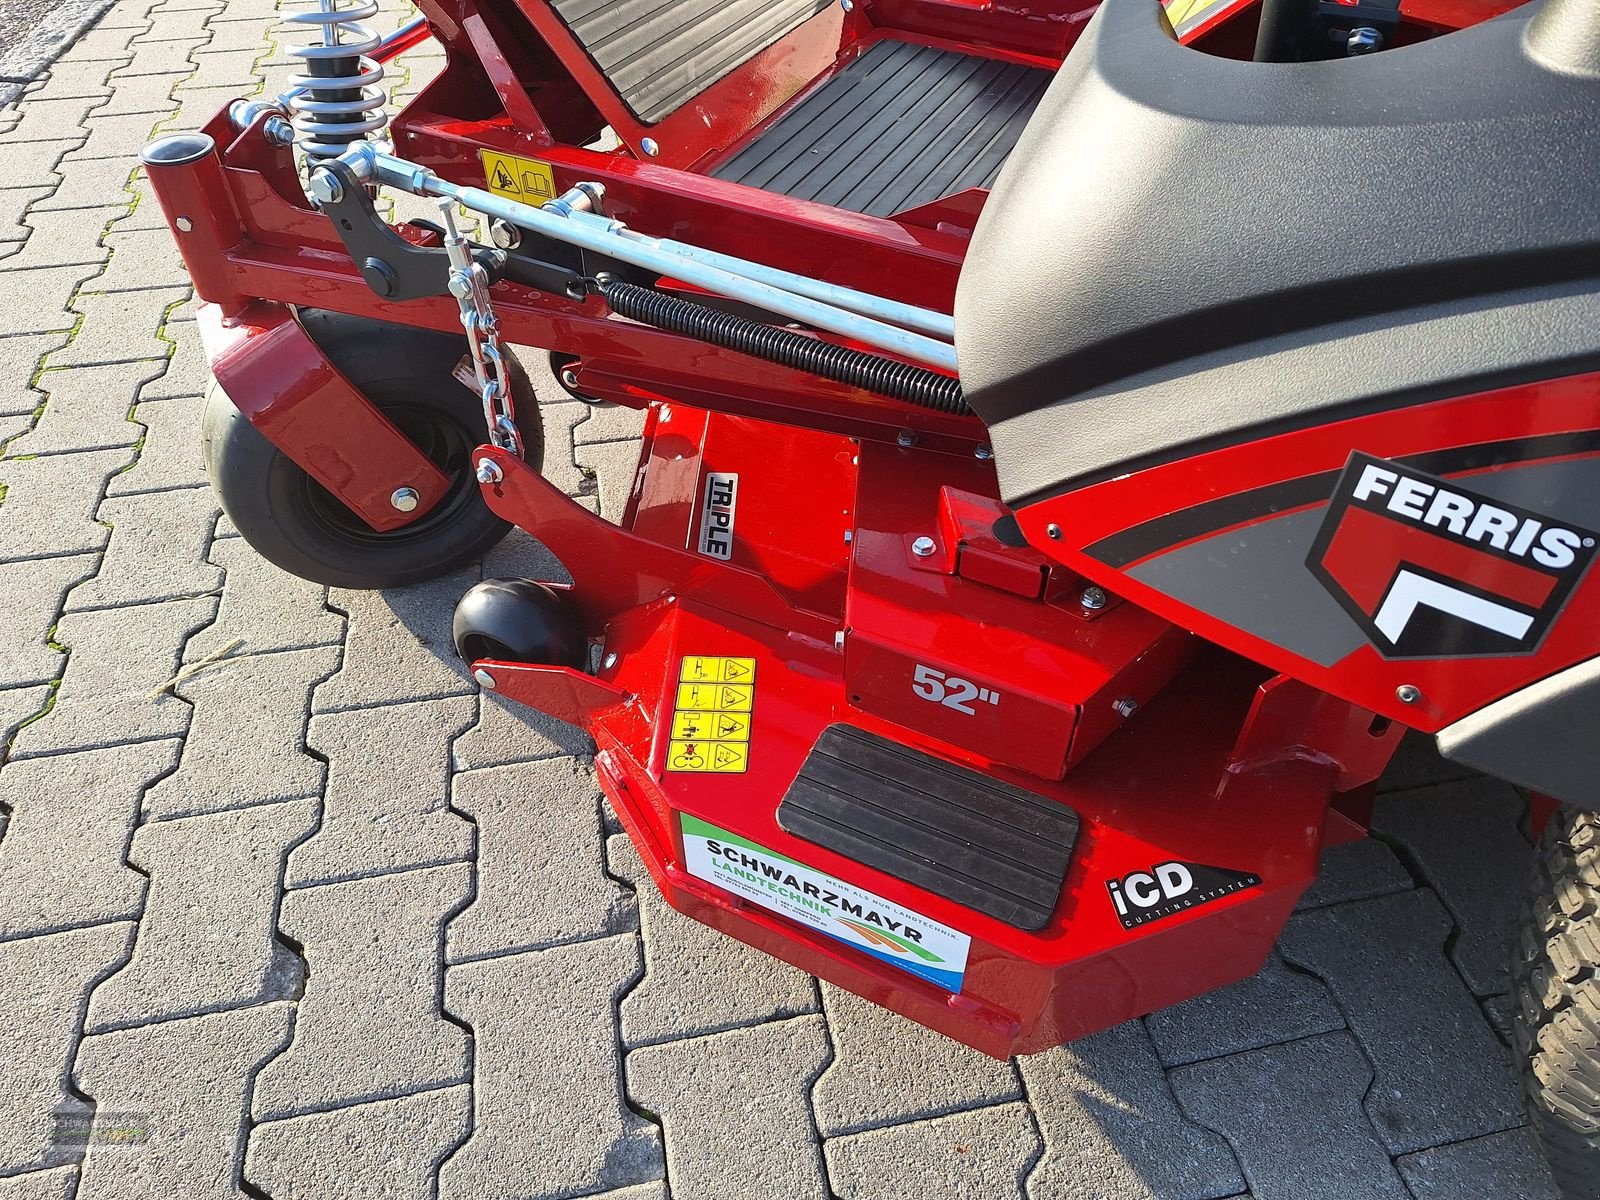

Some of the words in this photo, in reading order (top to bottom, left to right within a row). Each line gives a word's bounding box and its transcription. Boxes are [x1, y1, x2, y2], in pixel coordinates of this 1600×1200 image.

[707, 480, 733, 555] TRIPLE
[1352, 464, 1581, 568] FERRIS
[912, 664, 999, 715] 52"
[706, 840, 923, 944] SCHWARZMAYR
[712, 857, 832, 917] LANDTECHNIK
[826, 879, 850, 892] MEHR
[853, 891, 869, 901] ALS
[872, 899, 891, 910] NUR
[894, 909, 960, 941] LANDTECHNIK.
[1110, 863, 1192, 915] iCD
[1125, 900, 1192, 927] CUTTING
[1199, 878, 1255, 902] SYSTEM
